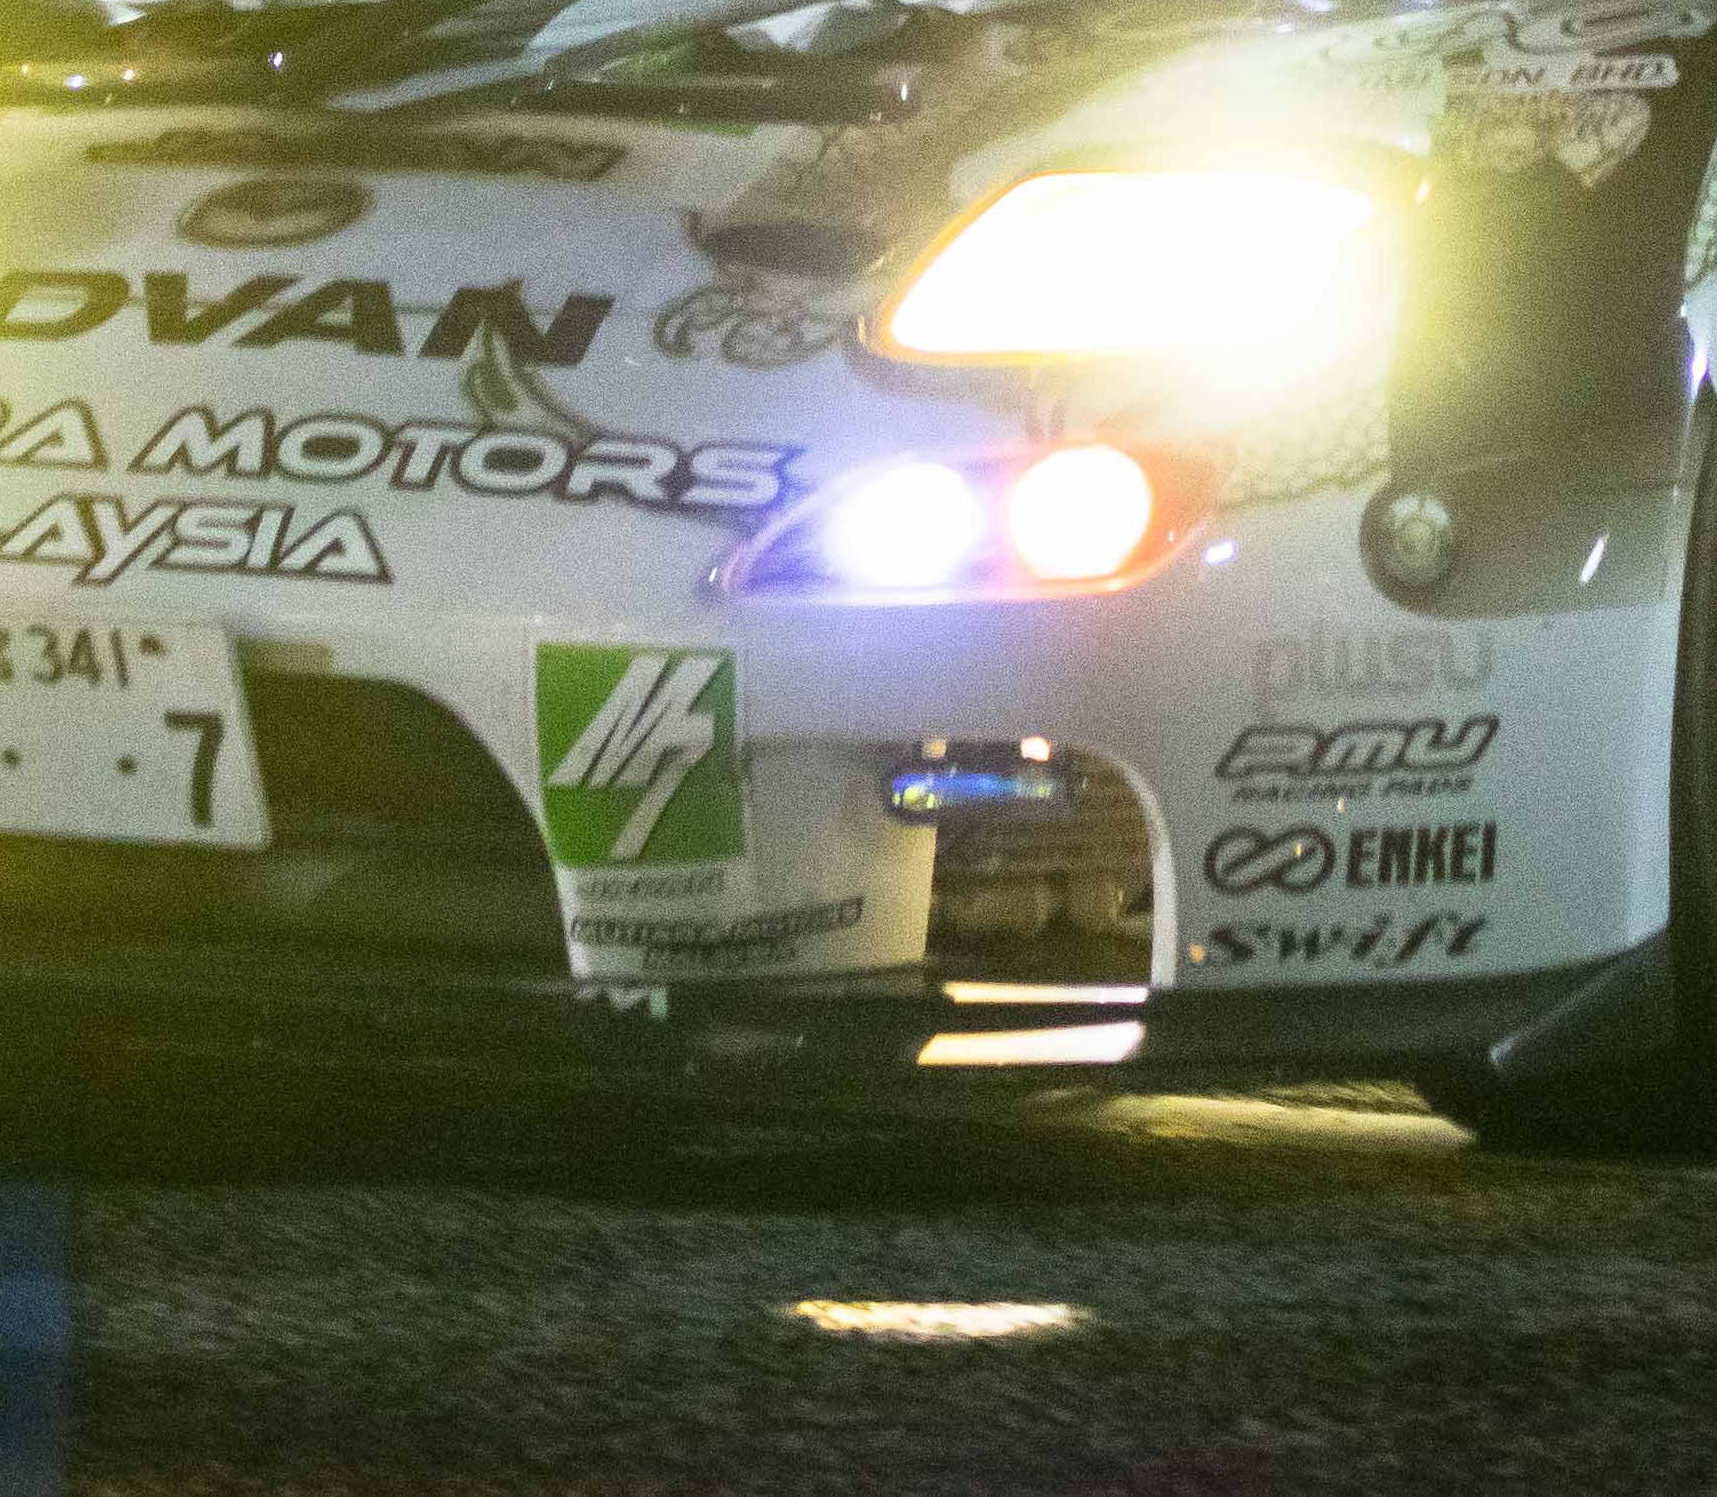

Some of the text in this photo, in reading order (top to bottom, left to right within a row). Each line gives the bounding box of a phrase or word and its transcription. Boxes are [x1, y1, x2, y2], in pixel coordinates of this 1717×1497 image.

[127, 403, 801, 508] MOTORS
[27, 624, 130, 689] 341
[1345, 821, 1498, 889] ENKEI
